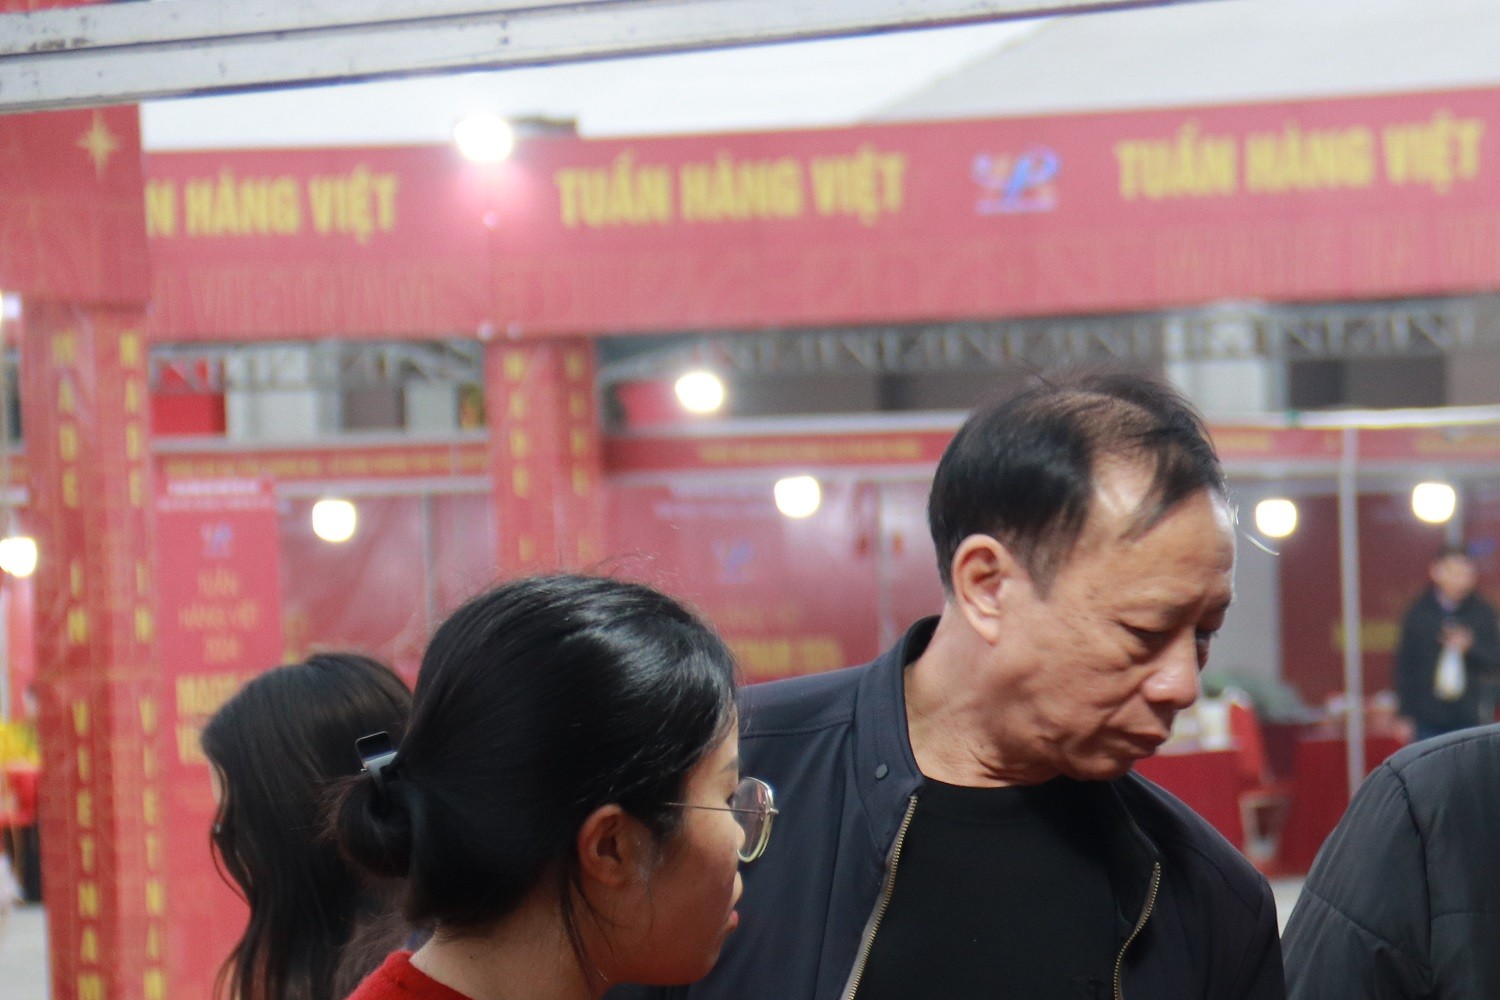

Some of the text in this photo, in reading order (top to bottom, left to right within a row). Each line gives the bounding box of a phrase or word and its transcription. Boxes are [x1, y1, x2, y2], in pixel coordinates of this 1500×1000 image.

[807, 140, 907, 228] VIỆT
[1382, 108, 1484, 195] VIỆT
[308, 162, 397, 246] VIỆT
